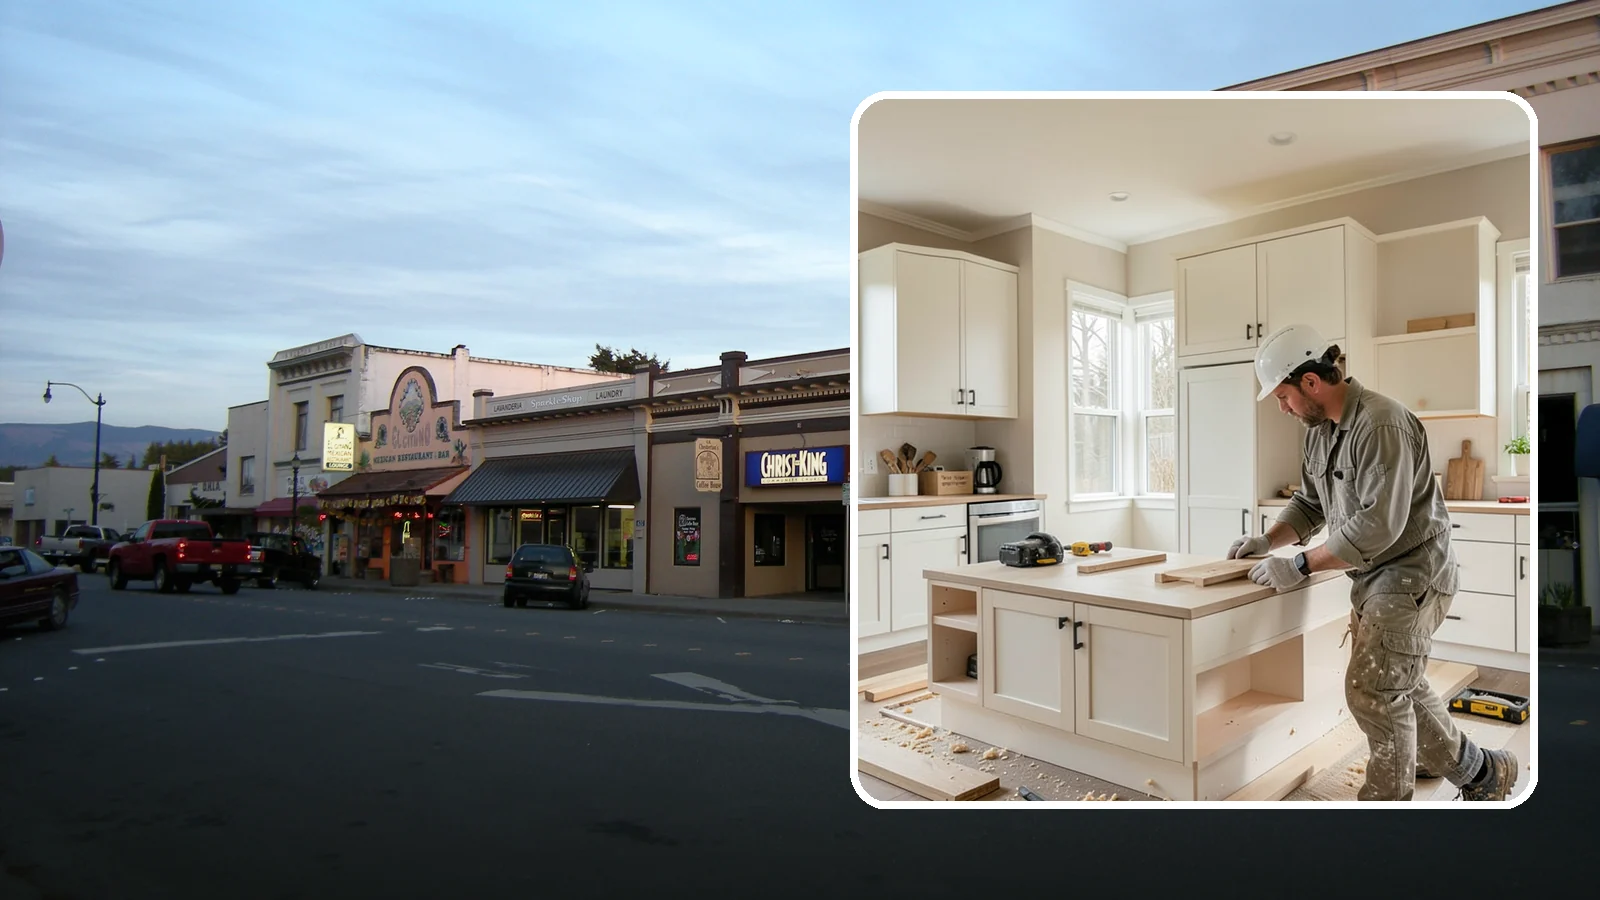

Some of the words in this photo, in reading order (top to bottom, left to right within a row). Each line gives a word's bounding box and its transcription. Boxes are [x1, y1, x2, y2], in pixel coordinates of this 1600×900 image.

[493, 402, 522, 413] LAVANDERIA
[530, 398, 560, 409] Sparkle
[561, 394, 582, 405] Shop
[595, 389, 623, 400] LAUNDRY
[373, 455, 397, 464] MEXICAN
[397, 451, 434, 463] RESTAURANT
[437, 450, 450, 459] BAR
[761, 452, 797, 478] CHRIST
[799, 450, 827, 476] KING
[697, 481, 709, 489] Coffee
